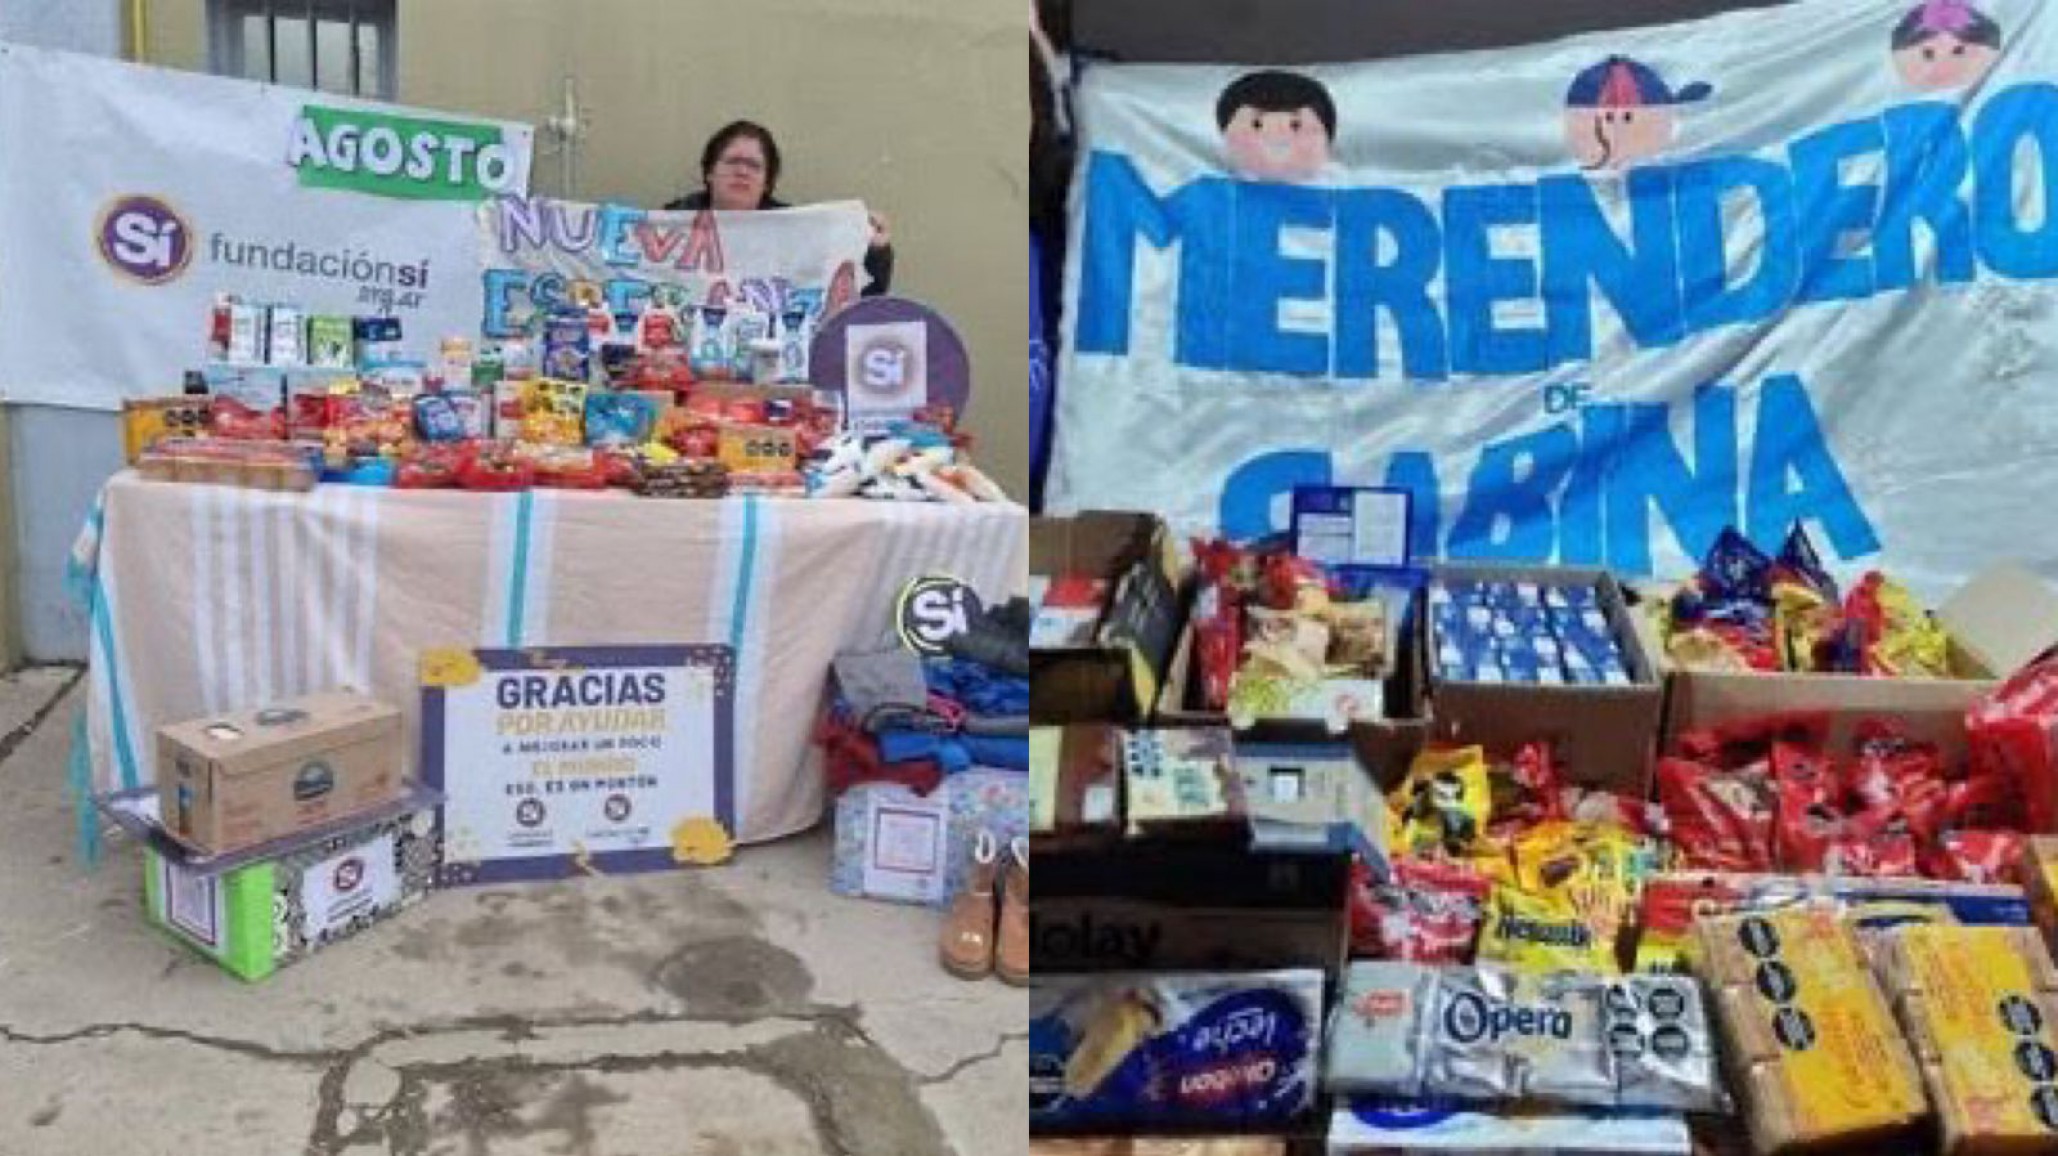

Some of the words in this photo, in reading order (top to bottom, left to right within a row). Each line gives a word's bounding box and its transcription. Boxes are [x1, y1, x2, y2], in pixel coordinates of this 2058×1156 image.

[289, 118, 512, 191] AGOSTO
[114, 211, 178, 268] Sí
[502, 195, 725, 272] NUEVA
[1076, 82, 2058, 380] MERENDERO
[496, 673, 666, 708] GRACIAS
[1444, 991, 1573, 1044] Opera
